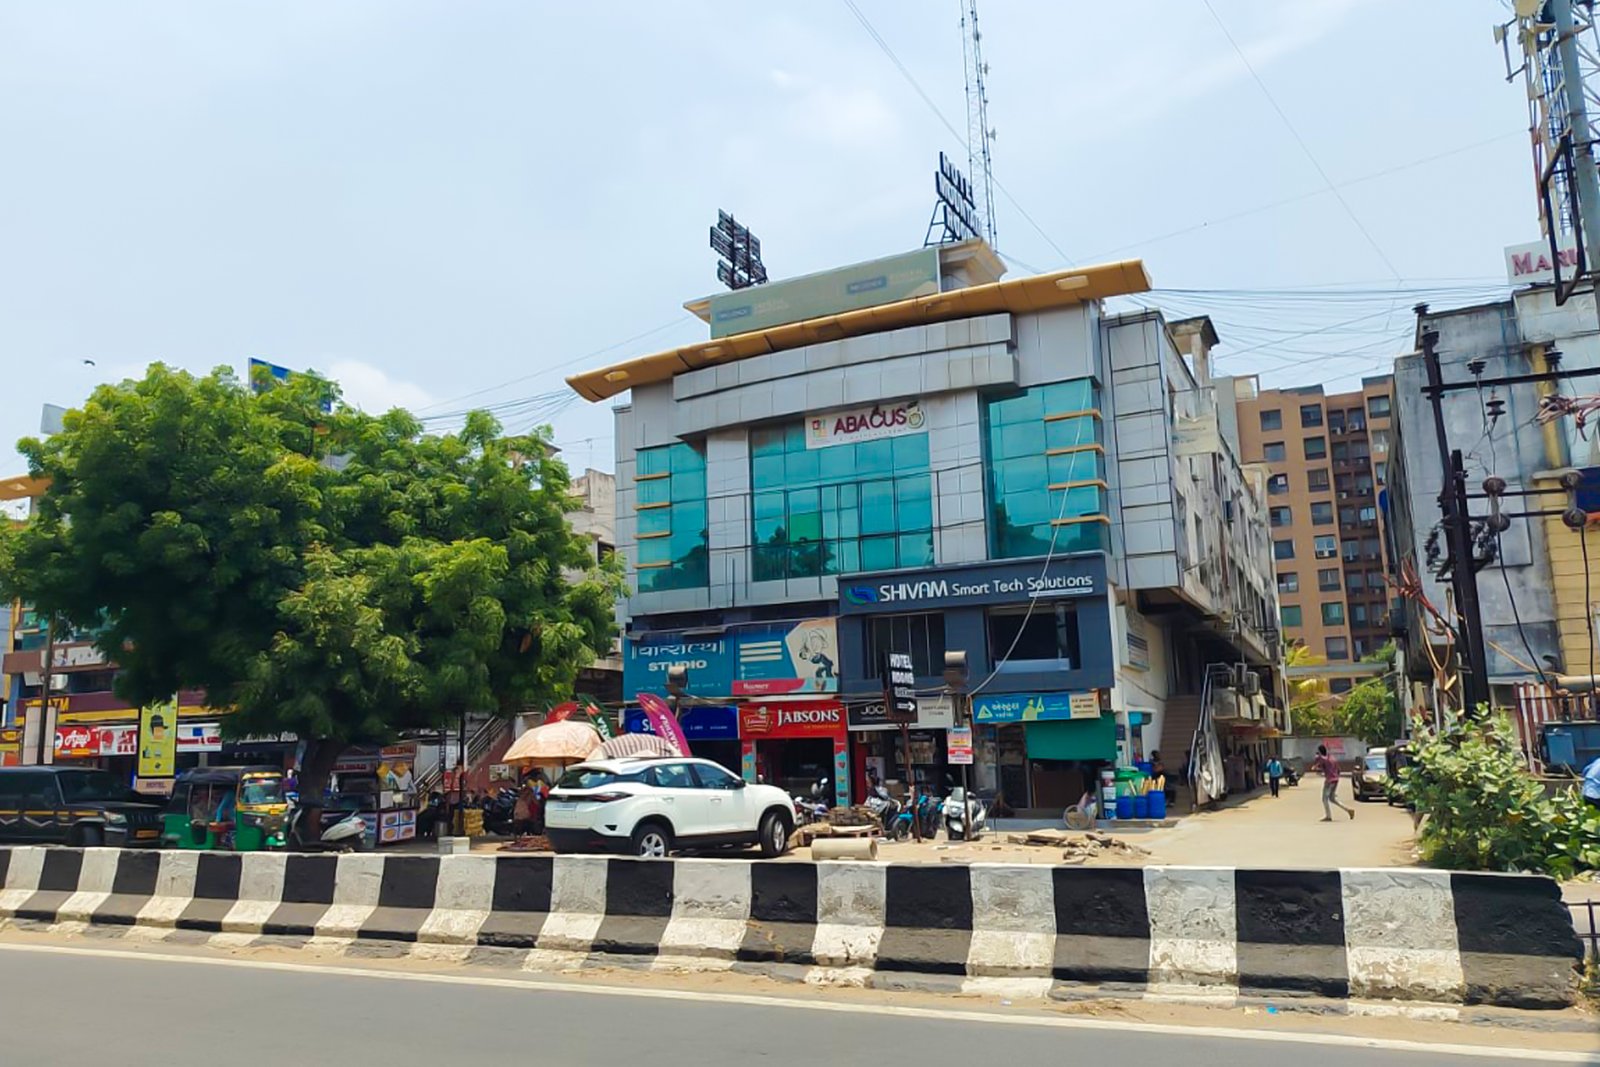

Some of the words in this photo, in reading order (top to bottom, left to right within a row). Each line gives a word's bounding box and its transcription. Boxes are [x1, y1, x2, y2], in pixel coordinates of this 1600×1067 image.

[833, 403, 908, 435] ABACUS
[879, 579, 948, 602] SHIVAM
[951, 581, 990, 597] Smart
[993, 578, 1023, 593] Tech
[1026, 575, 1093, 590] Solutions
[889, 653, 913, 670] HOTEL
[777, 708, 840, 727] JABSONS
